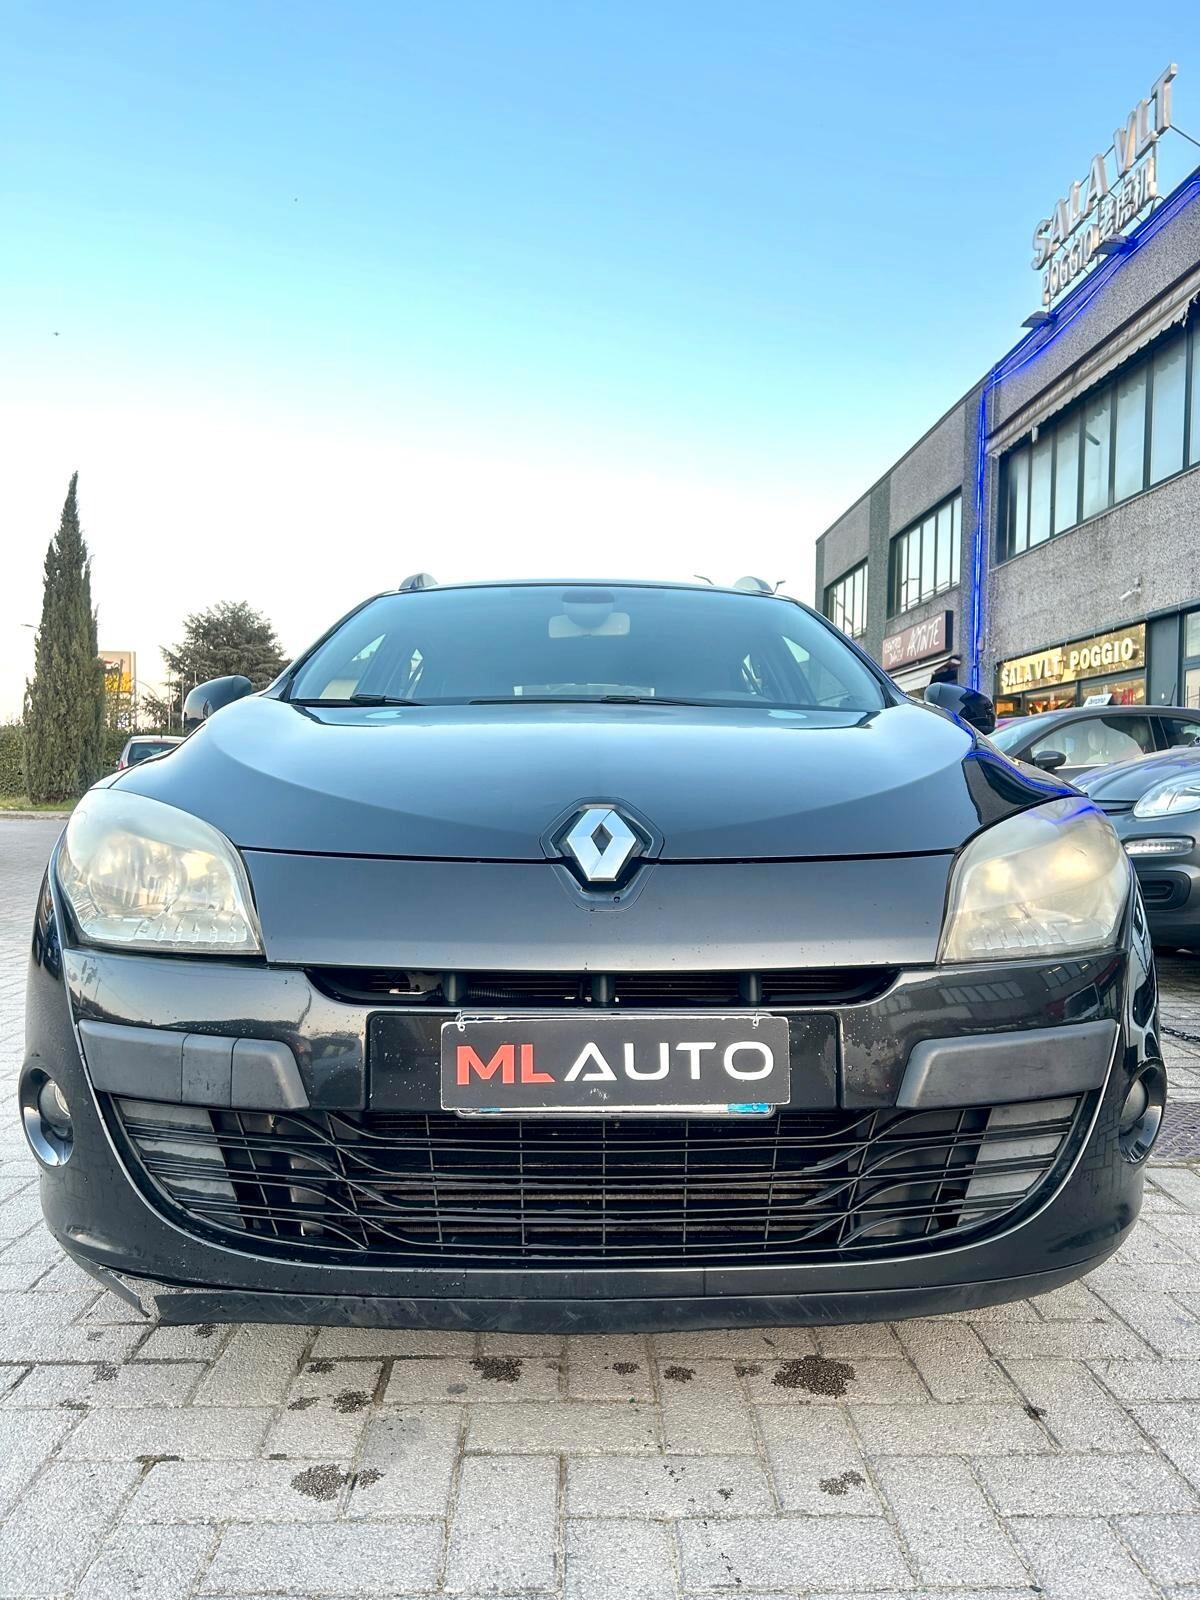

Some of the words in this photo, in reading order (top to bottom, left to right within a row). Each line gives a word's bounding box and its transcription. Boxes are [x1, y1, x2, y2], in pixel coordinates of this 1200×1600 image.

[1031, 153, 1109, 271] SALA
[1113, 63, 1178, 179] VLT
[1041, 223, 1100, 306] POGGIO
[1001, 661, 1032, 687] SALA
[1033, 655, 1063, 682] VLT
[1069, 637, 1134, 671] POGGIO
[456, 1043, 556, 1086] ML
[563, 1041, 775, 1082] AUTO
